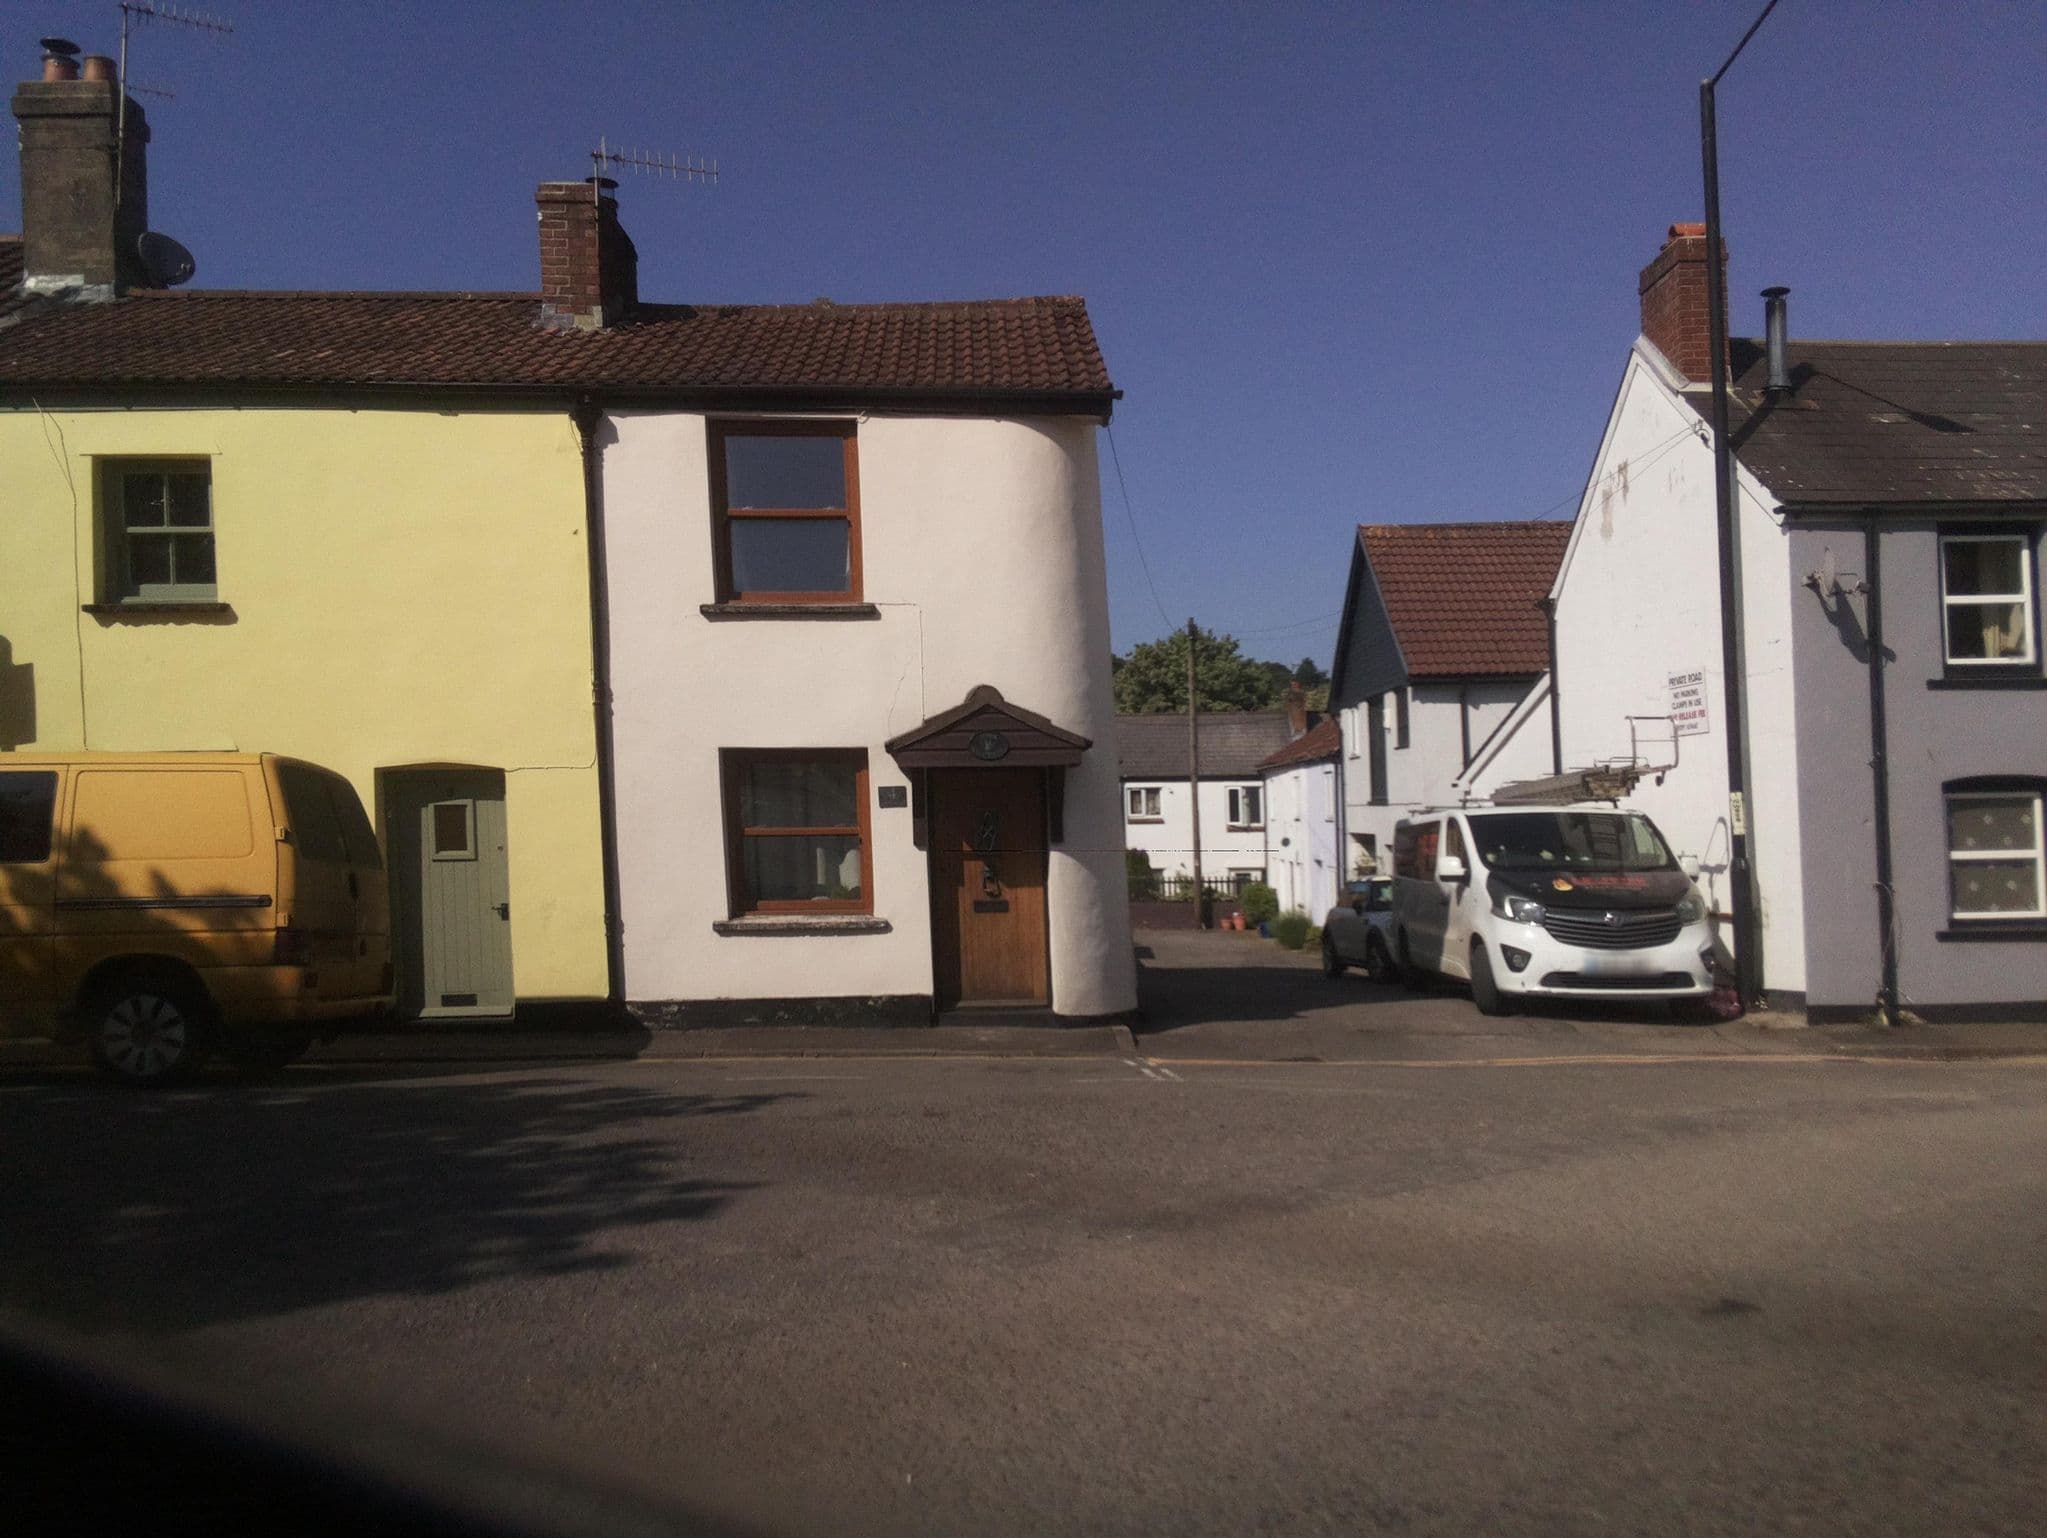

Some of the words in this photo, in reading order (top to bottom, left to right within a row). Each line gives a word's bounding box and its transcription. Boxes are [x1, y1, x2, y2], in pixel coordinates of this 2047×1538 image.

[1669, 675, 1687, 686] PRIVATE
[1688, 672, 1702, 683] ROAD
[1681, 688, 1698, 697] PARKING
[1694, 698, 1702, 706] USE
[1679, 711, 1697, 720] RELEASE
[1698, 709, 1706, 718] FEE
